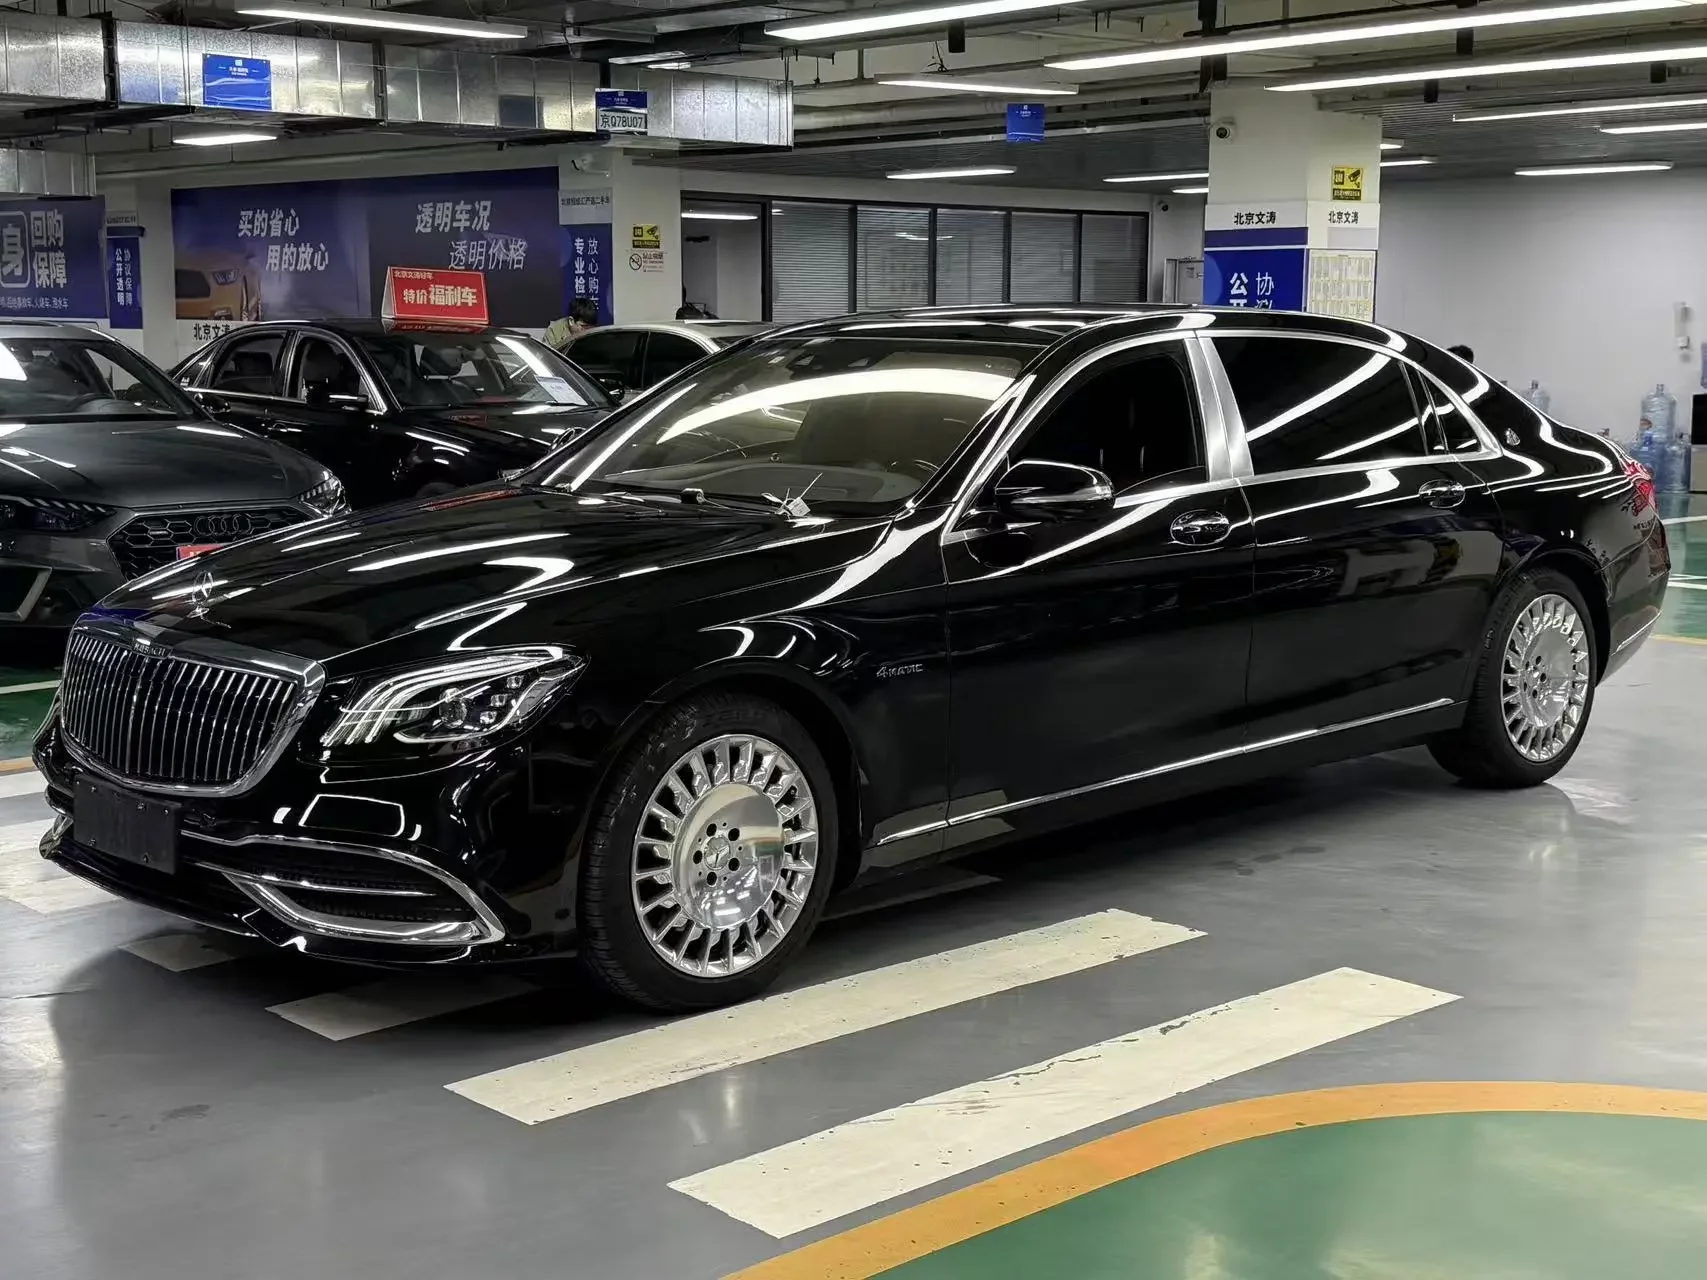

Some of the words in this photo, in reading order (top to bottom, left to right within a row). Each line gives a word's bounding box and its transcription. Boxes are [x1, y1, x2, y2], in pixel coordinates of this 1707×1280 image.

[30, 210, 64, 248] 回购
[238, 208, 300, 237] 买的省心
[415, 199, 492, 233] 透明车况
[1233, 211, 1276, 225] 北京文涛
[1328, 211, 1359, 224] 北京文涛
[265, 243, 329, 272] 用的放心
[448, 239, 528, 270] 透明价格
[574, 237, 586, 299] 专业检
[33, 252, 67, 288] 保障
[403, 284, 478, 306] 特价福利车
